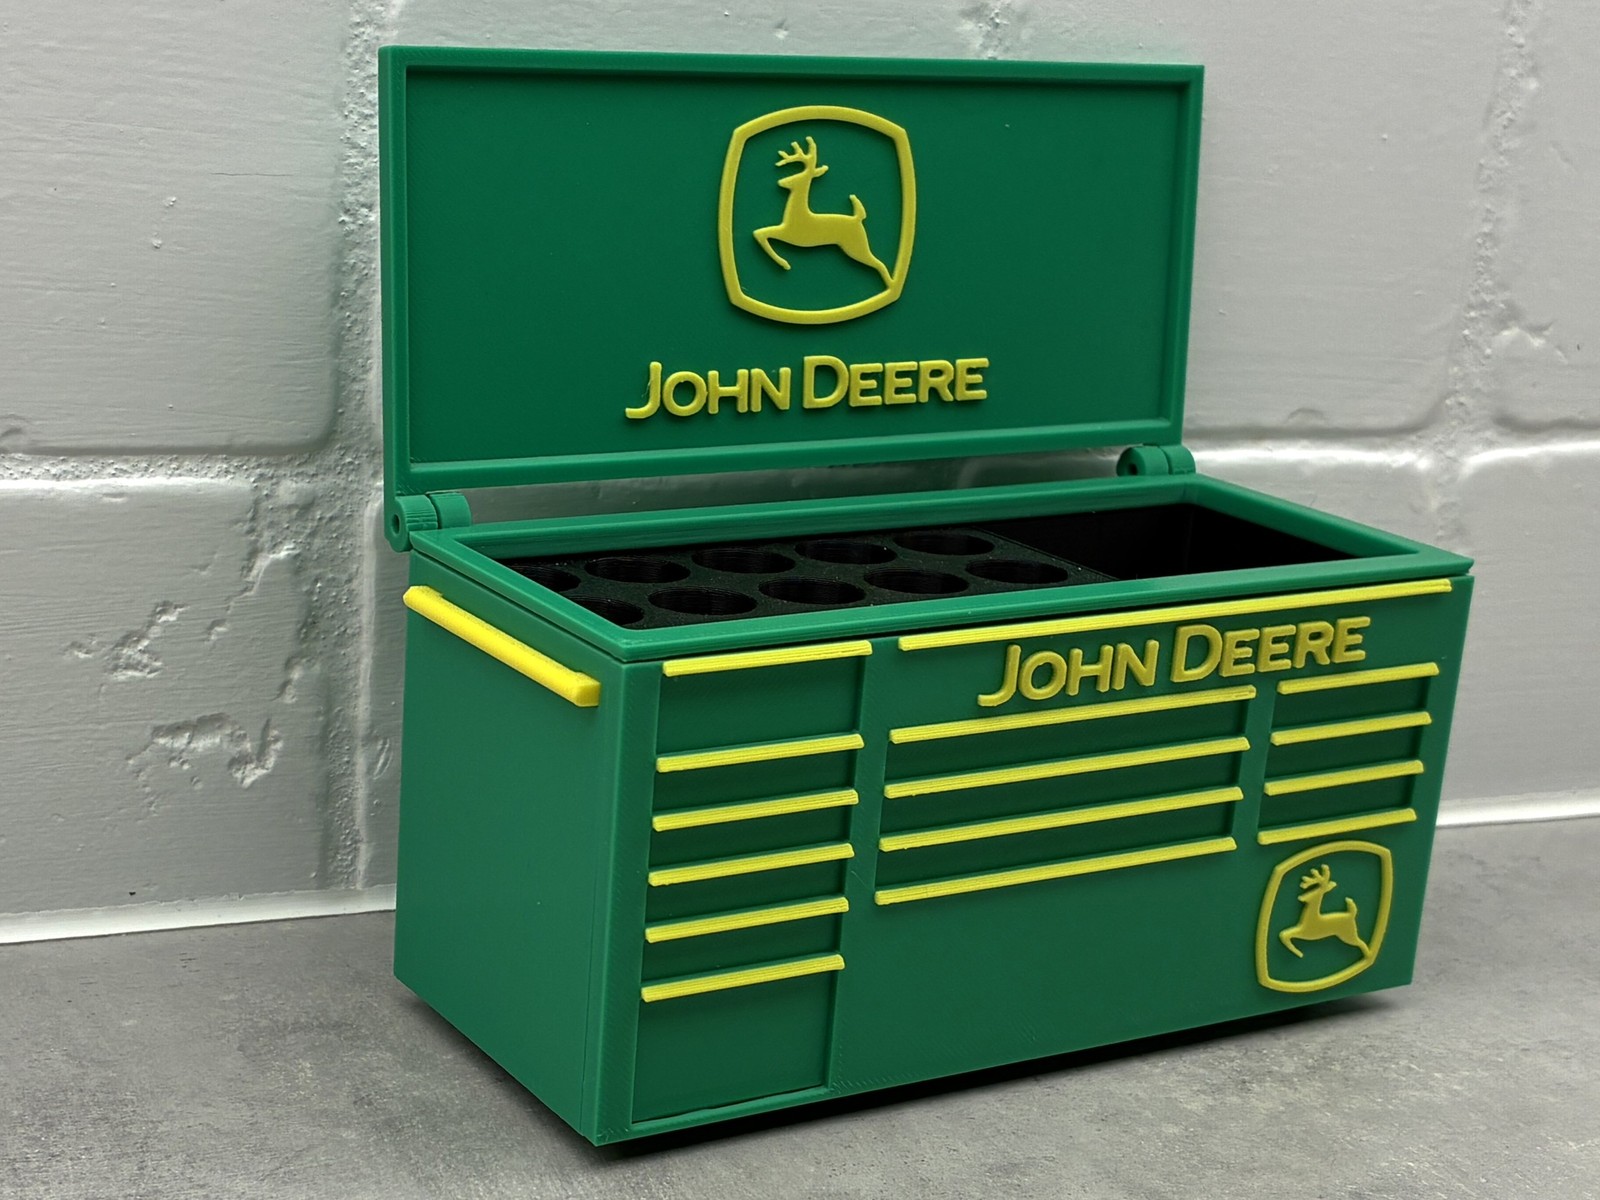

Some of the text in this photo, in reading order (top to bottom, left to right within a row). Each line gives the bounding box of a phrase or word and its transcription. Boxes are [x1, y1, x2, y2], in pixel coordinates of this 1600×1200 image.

[625, 355, 989, 419] JOHN DEERE
[978, 616, 1372, 707] JOHN DEERE
